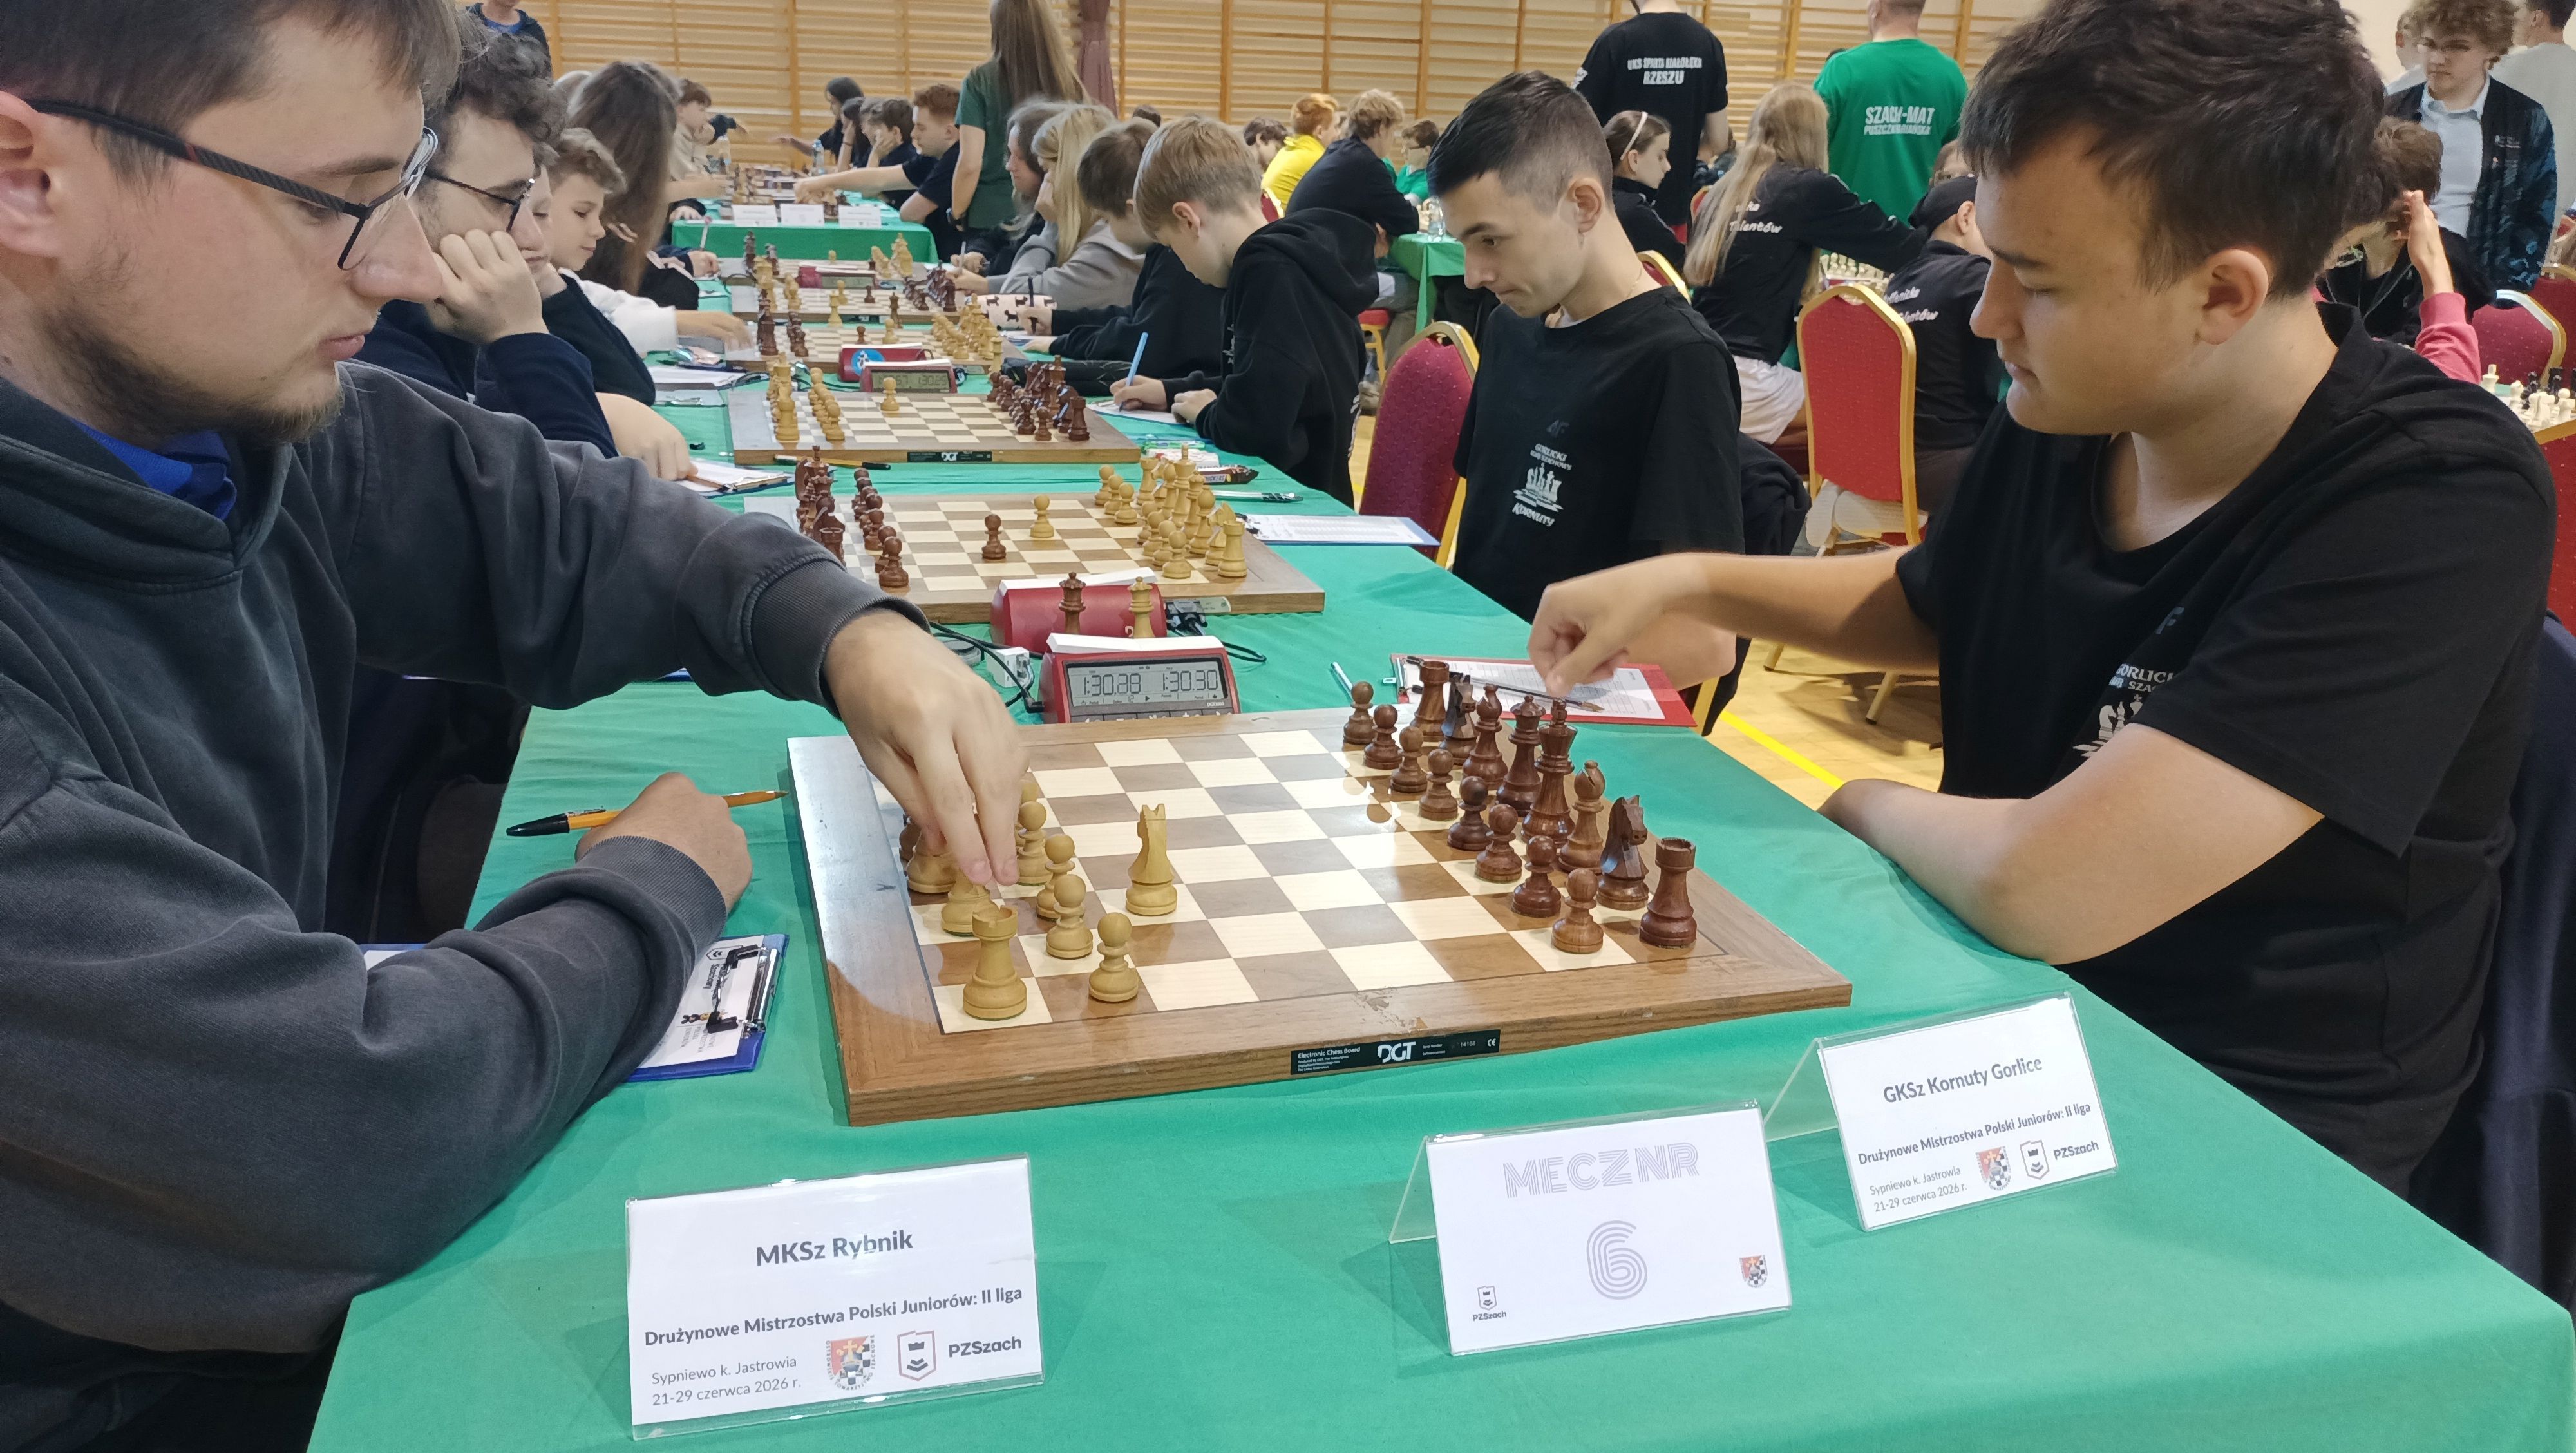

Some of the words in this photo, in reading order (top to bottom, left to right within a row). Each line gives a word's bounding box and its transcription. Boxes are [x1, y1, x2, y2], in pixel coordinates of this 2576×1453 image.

[1865, 106, 1935, 124] SZACH-MAT
[1162, 670, 1218, 692] 1:30.30
[2128, 681, 2156, 692] SZA
[1298, 1050, 1325, 1059] Electronic
[1378, 1041, 1416, 1063] DGT
[1883, 1081, 1926, 1103] GKSz
[1927, 1070, 1987, 1094] Kornuty
[1991, 1058, 2043, 1079] Gorlice
[1858, 1144, 1919, 1165] Drużynowe
[1920, 1130, 1984, 1150] Mistrzostwa
[1985, 1118, 2015, 1135] Polski
[2017, 1110, 2065, 1129] Juniorów:
[2065, 1105, 2072, 1117] II
[2073, 1103, 2091, 1116] liga
[2053, 1141, 2099, 1160] PZSzach
[1870, 1179, 1911, 1196] Sypniewo
[1913, 1175, 1921, 1185] k.
[1923, 1166, 1961, 1183] Jastrowia
[1874, 1197, 1899, 1212] 21-29
[1902, 1190, 1936, 1206] czerwca
[1937, 1182, 1960, 1197] 2026
[1960, 1183, 1967, 1192] r.
[756, 1241, 825, 1266] MKSz
[833, 1230, 913, 1260] Rybnik
[1587, 1220, 1648, 1300] 6
[645, 1324, 739, 1345] Drużynowe
[744, 1312, 844, 1333] Mistrzostwa
[849, 1302, 896, 1320] Polski
[901, 1294, 977, 1314] Juniorów:
[982, 1289, 991, 1304] II
[996, 1288, 1022, 1303] liga
[1472, 1311, 1507, 1322] PZSzach
[949, 1336, 1022, 1358] PZSzach
[652, 1369, 716, 1385] Sypniewo
[720, 1364, 731, 1376] k.
[735, 1356, 797, 1374] Jastrowia
[652, 1390, 692, 1405] 21-29
[697, 1385, 750, 1400] czerwca
[755, 1377, 788, 1393] 2026
[793, 1378, 801, 1388] r.
